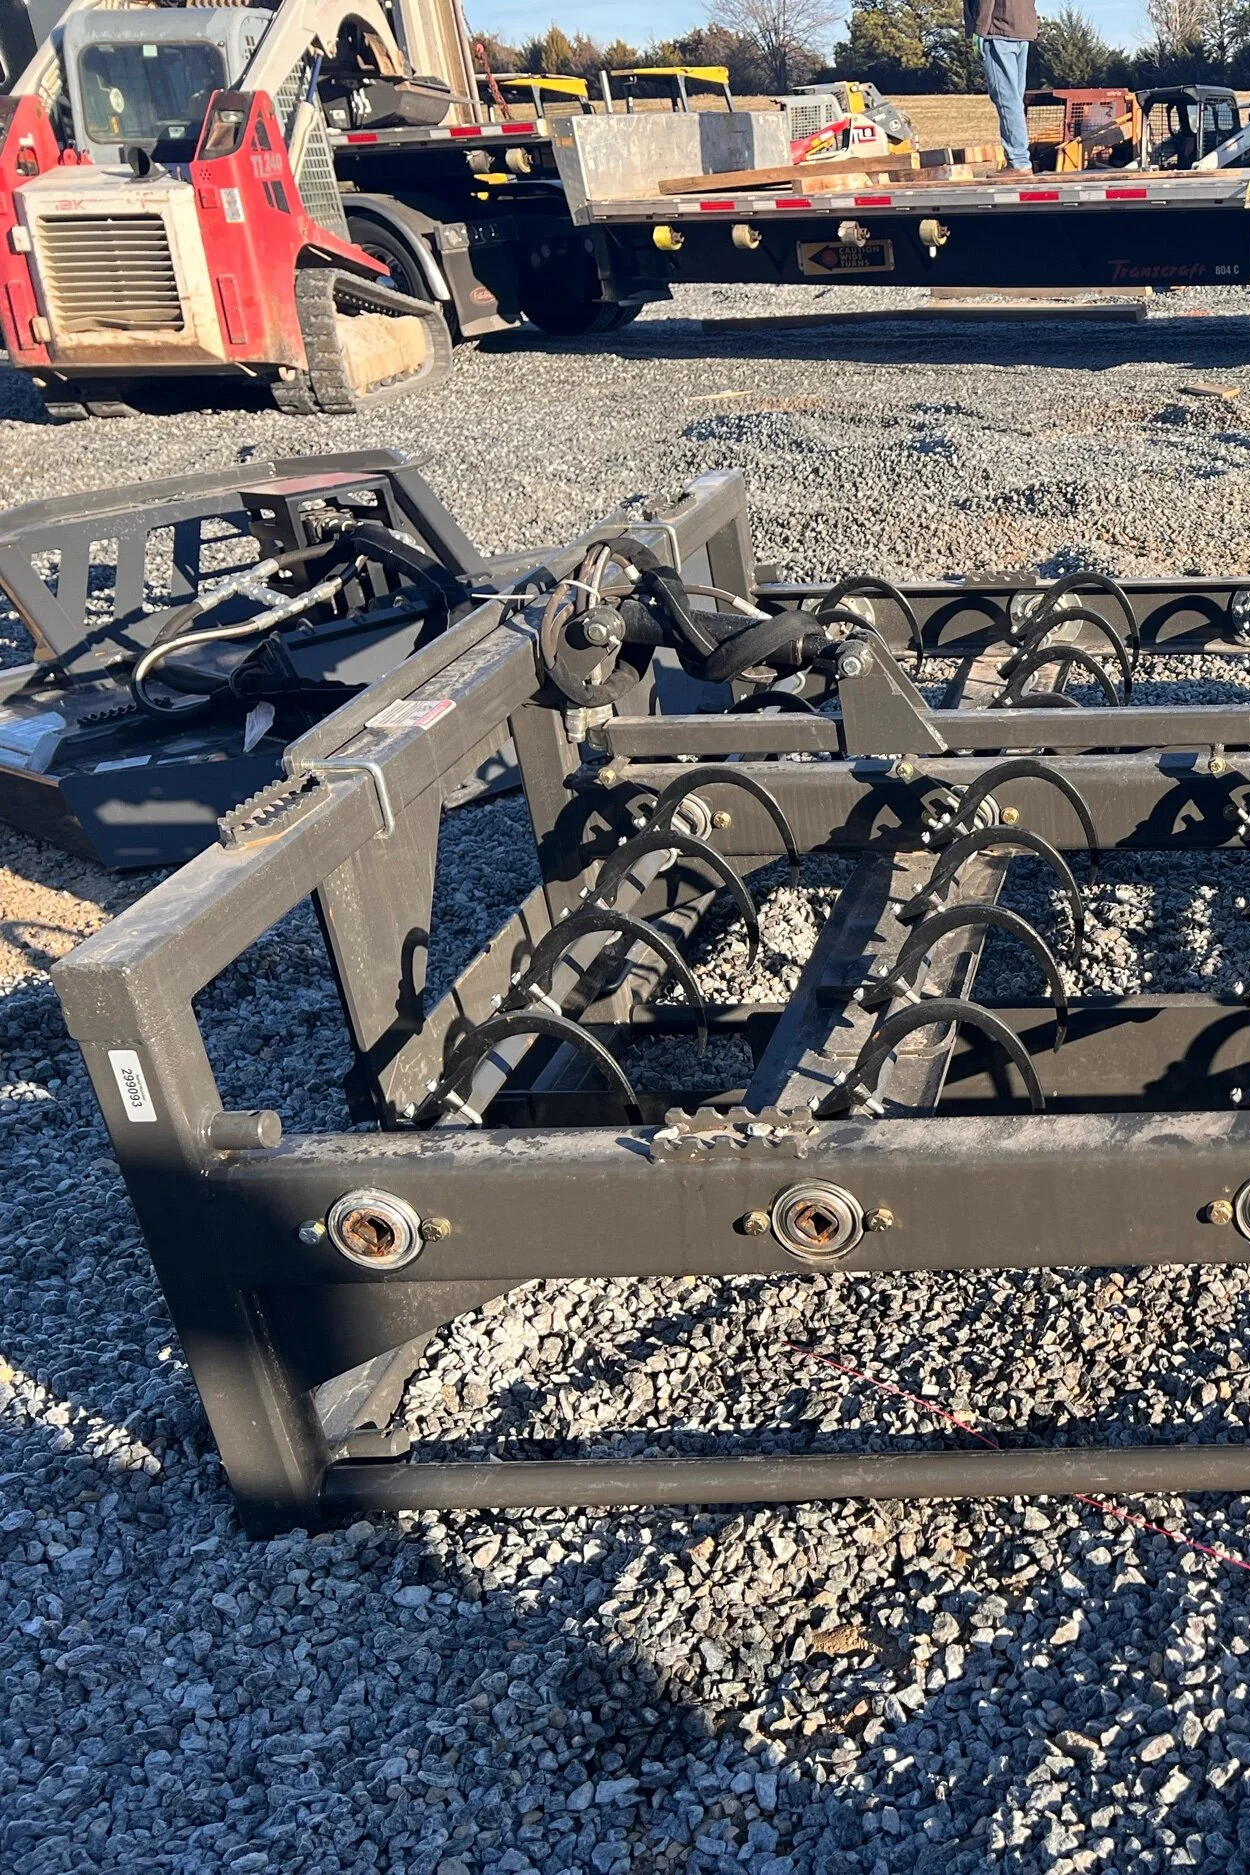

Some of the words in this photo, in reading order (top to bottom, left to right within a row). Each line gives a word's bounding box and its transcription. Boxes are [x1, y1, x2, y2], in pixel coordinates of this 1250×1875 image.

[1107, 259, 1206, 281] Transcraft
[1215, 265, 1231, 275] 804
[1233, 264, 1240, 275] C
[121, 1068, 143, 1108] 299093
